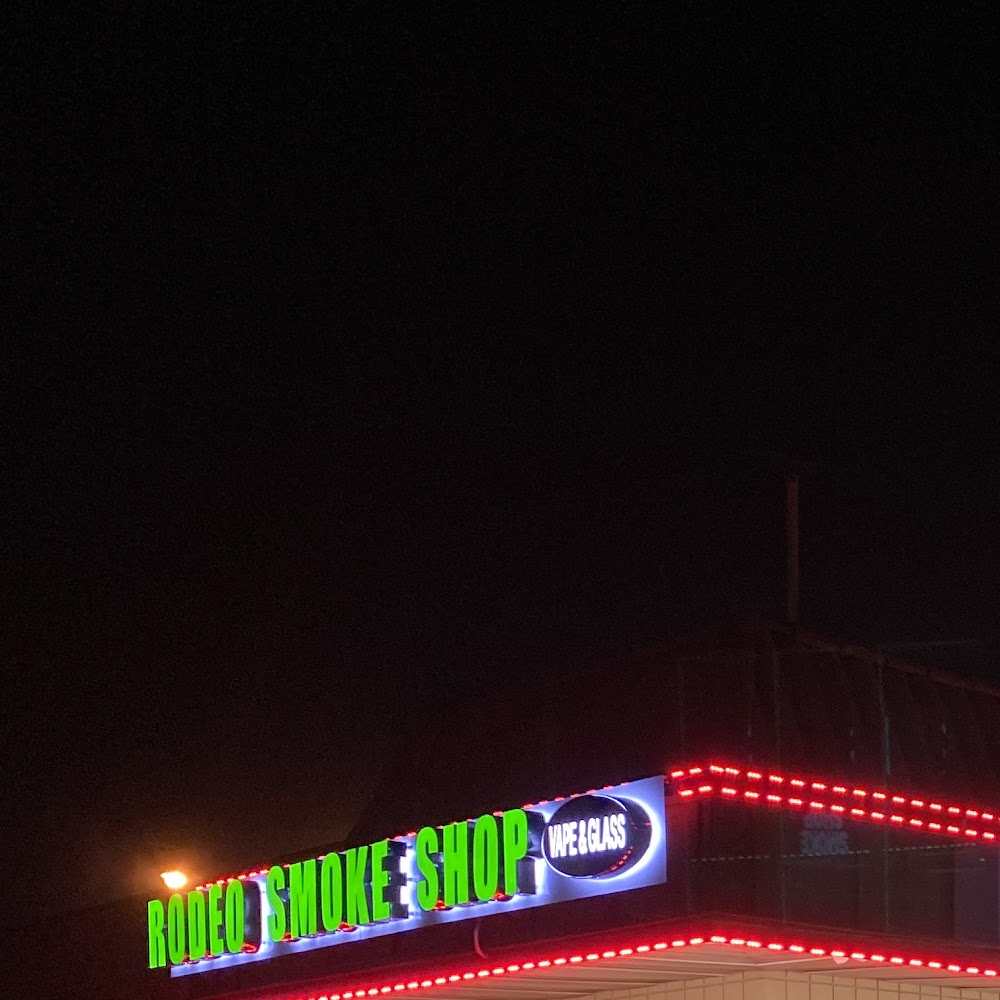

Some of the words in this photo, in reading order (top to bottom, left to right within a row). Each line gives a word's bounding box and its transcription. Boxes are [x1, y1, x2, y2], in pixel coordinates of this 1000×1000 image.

[548, 821, 578, 859] VAPE
[578, 820, 588, 855] &
[587, 813, 626, 853] GLASS
[147, 881, 245, 969] RODEO
[267, 841, 391, 942] SMOKE
[416, 808, 529, 911] SHOP
